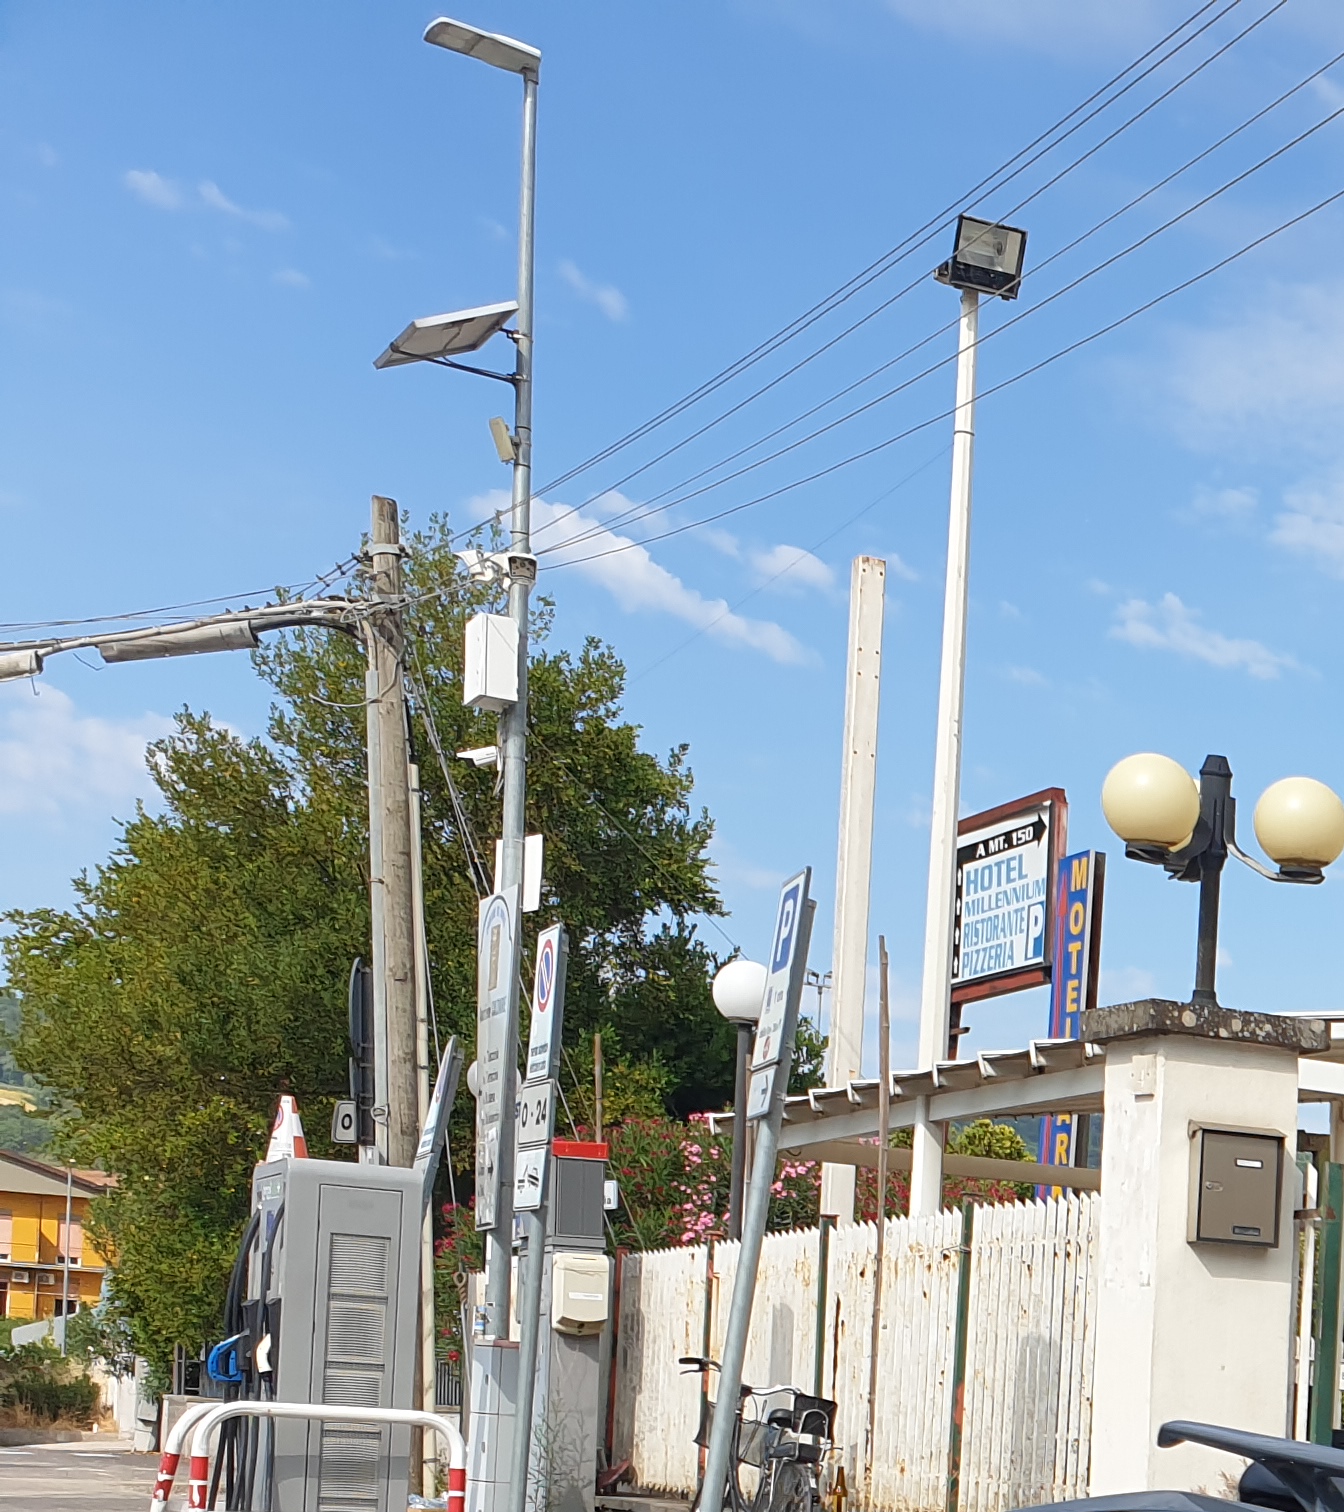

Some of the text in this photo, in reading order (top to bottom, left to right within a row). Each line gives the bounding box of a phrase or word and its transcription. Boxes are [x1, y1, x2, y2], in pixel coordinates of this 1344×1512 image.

[976, 826, 1034, 859] A MT. 150
[965, 853, 1029, 897] HOTEL
[964, 877, 1046, 919] MILLENNIUM
[776, 898, 794, 962] P
[963, 907, 1025, 950] RISTORANTE
[1028, 904, 1043, 959] P
[961, 939, 1015, 979] PIZZERIA
[535, 1098, 547, 1125] 24
